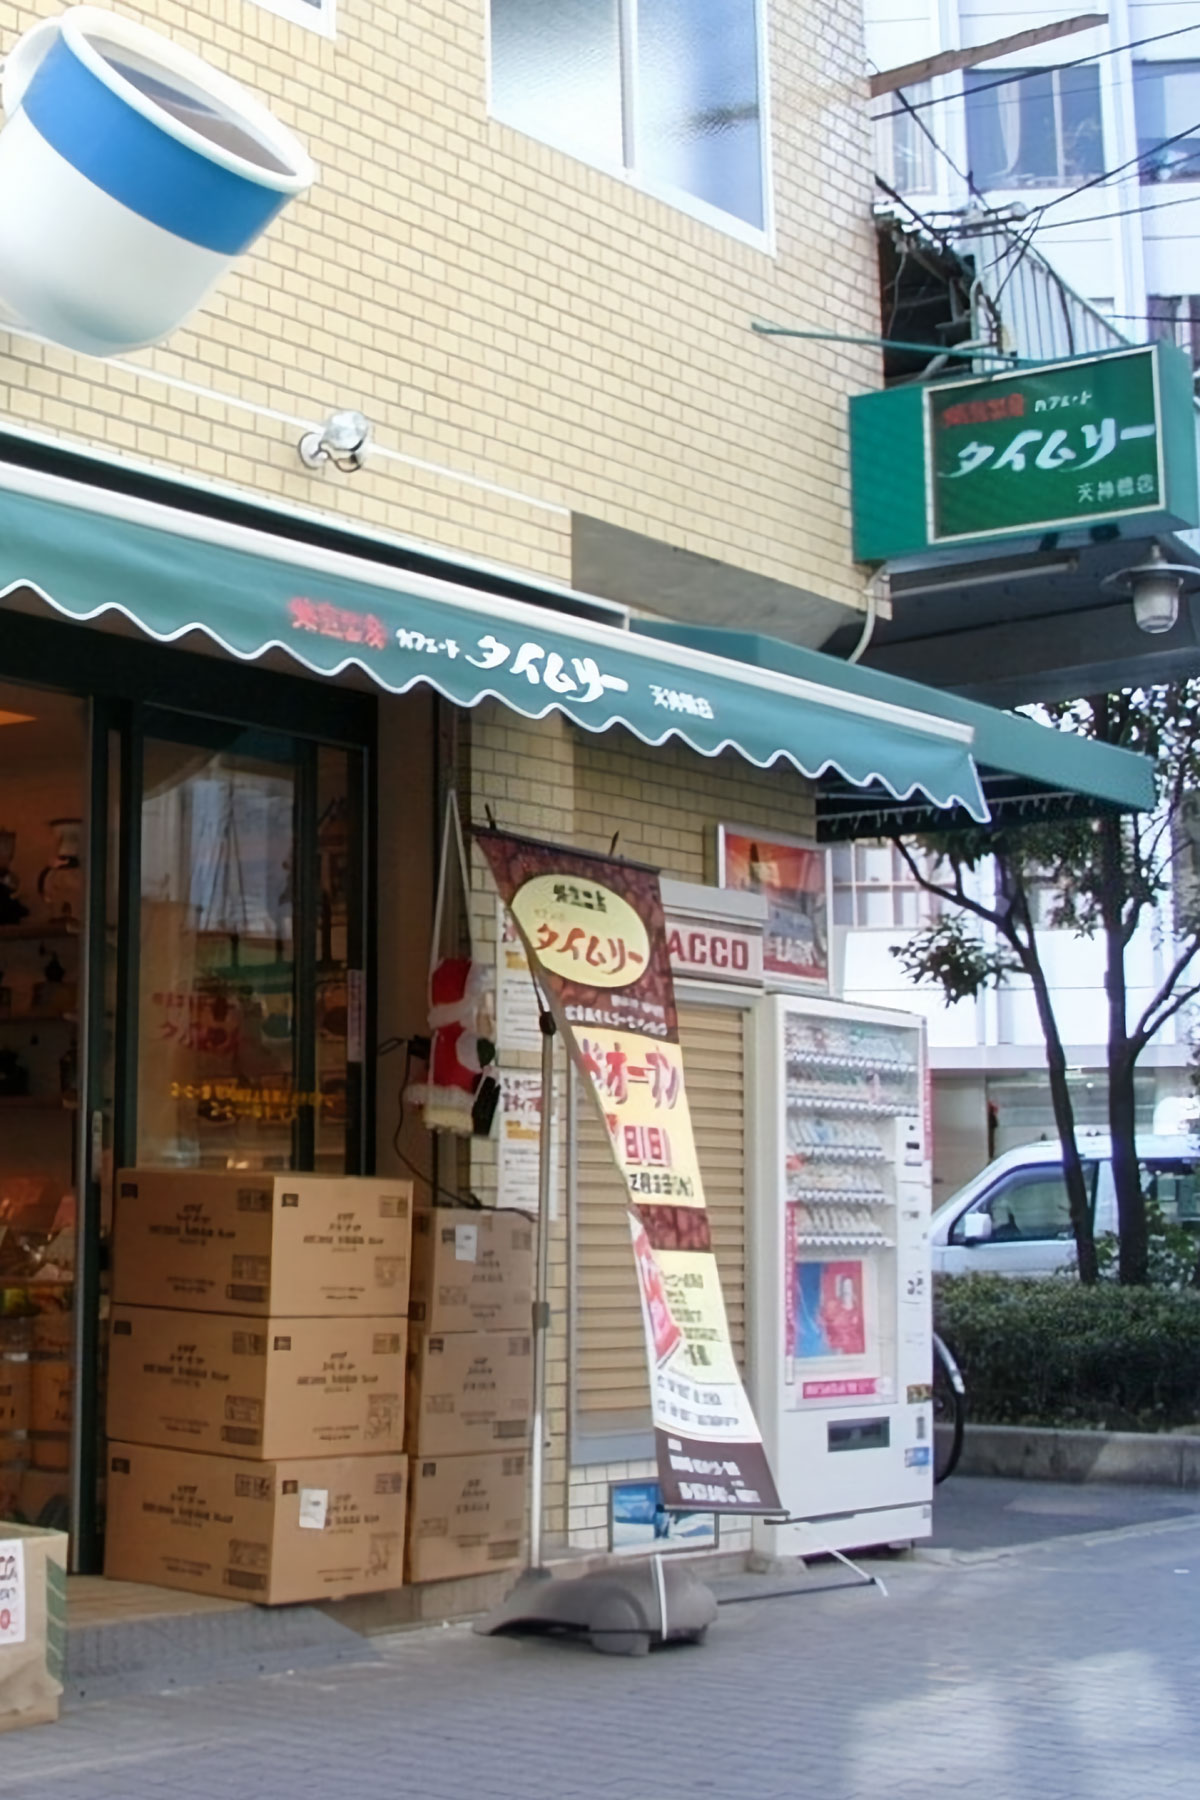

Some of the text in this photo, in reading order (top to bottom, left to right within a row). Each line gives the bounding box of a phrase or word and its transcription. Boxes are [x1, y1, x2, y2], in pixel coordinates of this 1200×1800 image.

[937, 418, 1155, 478] タイムリー
[466, 634, 629, 702] タイムリー
[535, 922, 644, 974] タイムリー
